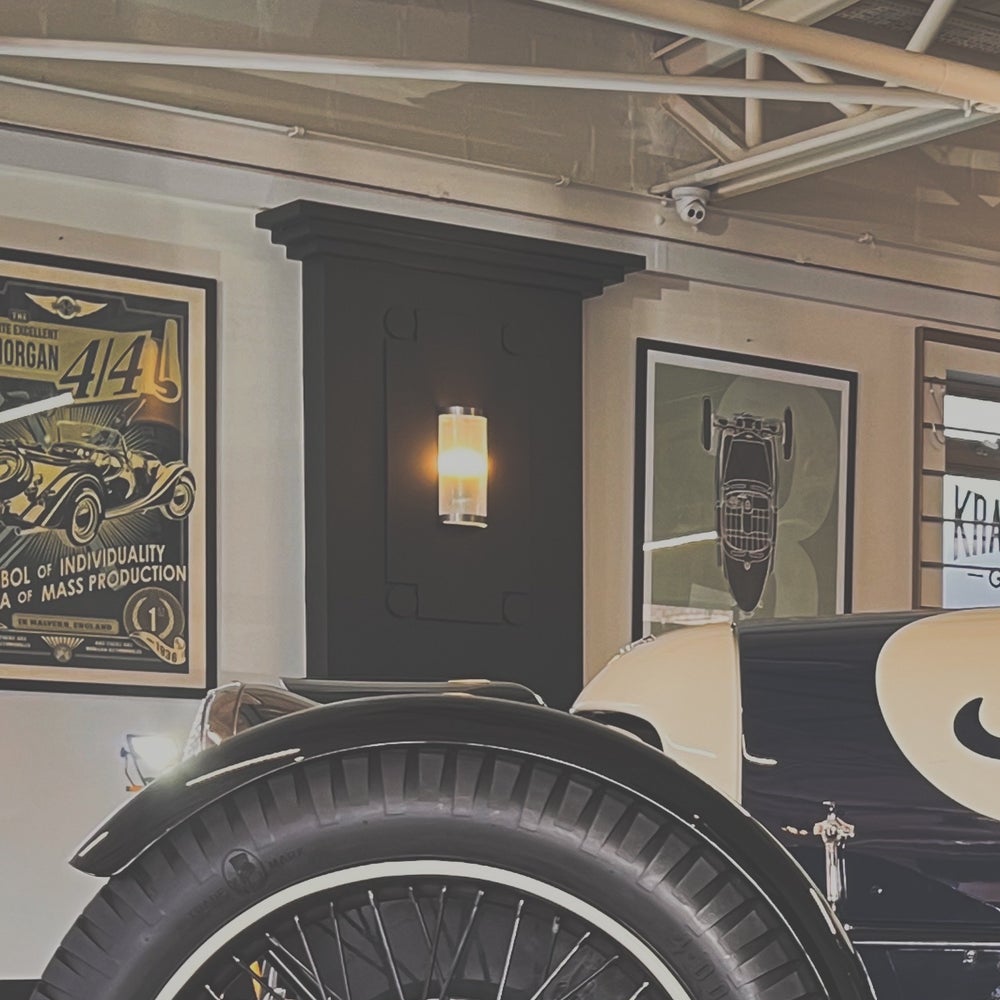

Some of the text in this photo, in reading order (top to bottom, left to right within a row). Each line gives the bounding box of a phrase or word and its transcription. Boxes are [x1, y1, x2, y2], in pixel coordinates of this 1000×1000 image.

[59, 335, 147, 399] 4/4
[1, 544, 165, 589] BOL OF INDIVIDUALITY
[17, 589, 33, 604] OF
[41, 577, 84, 602] MASS
[88, 565, 187, 591] PRODUCTION
